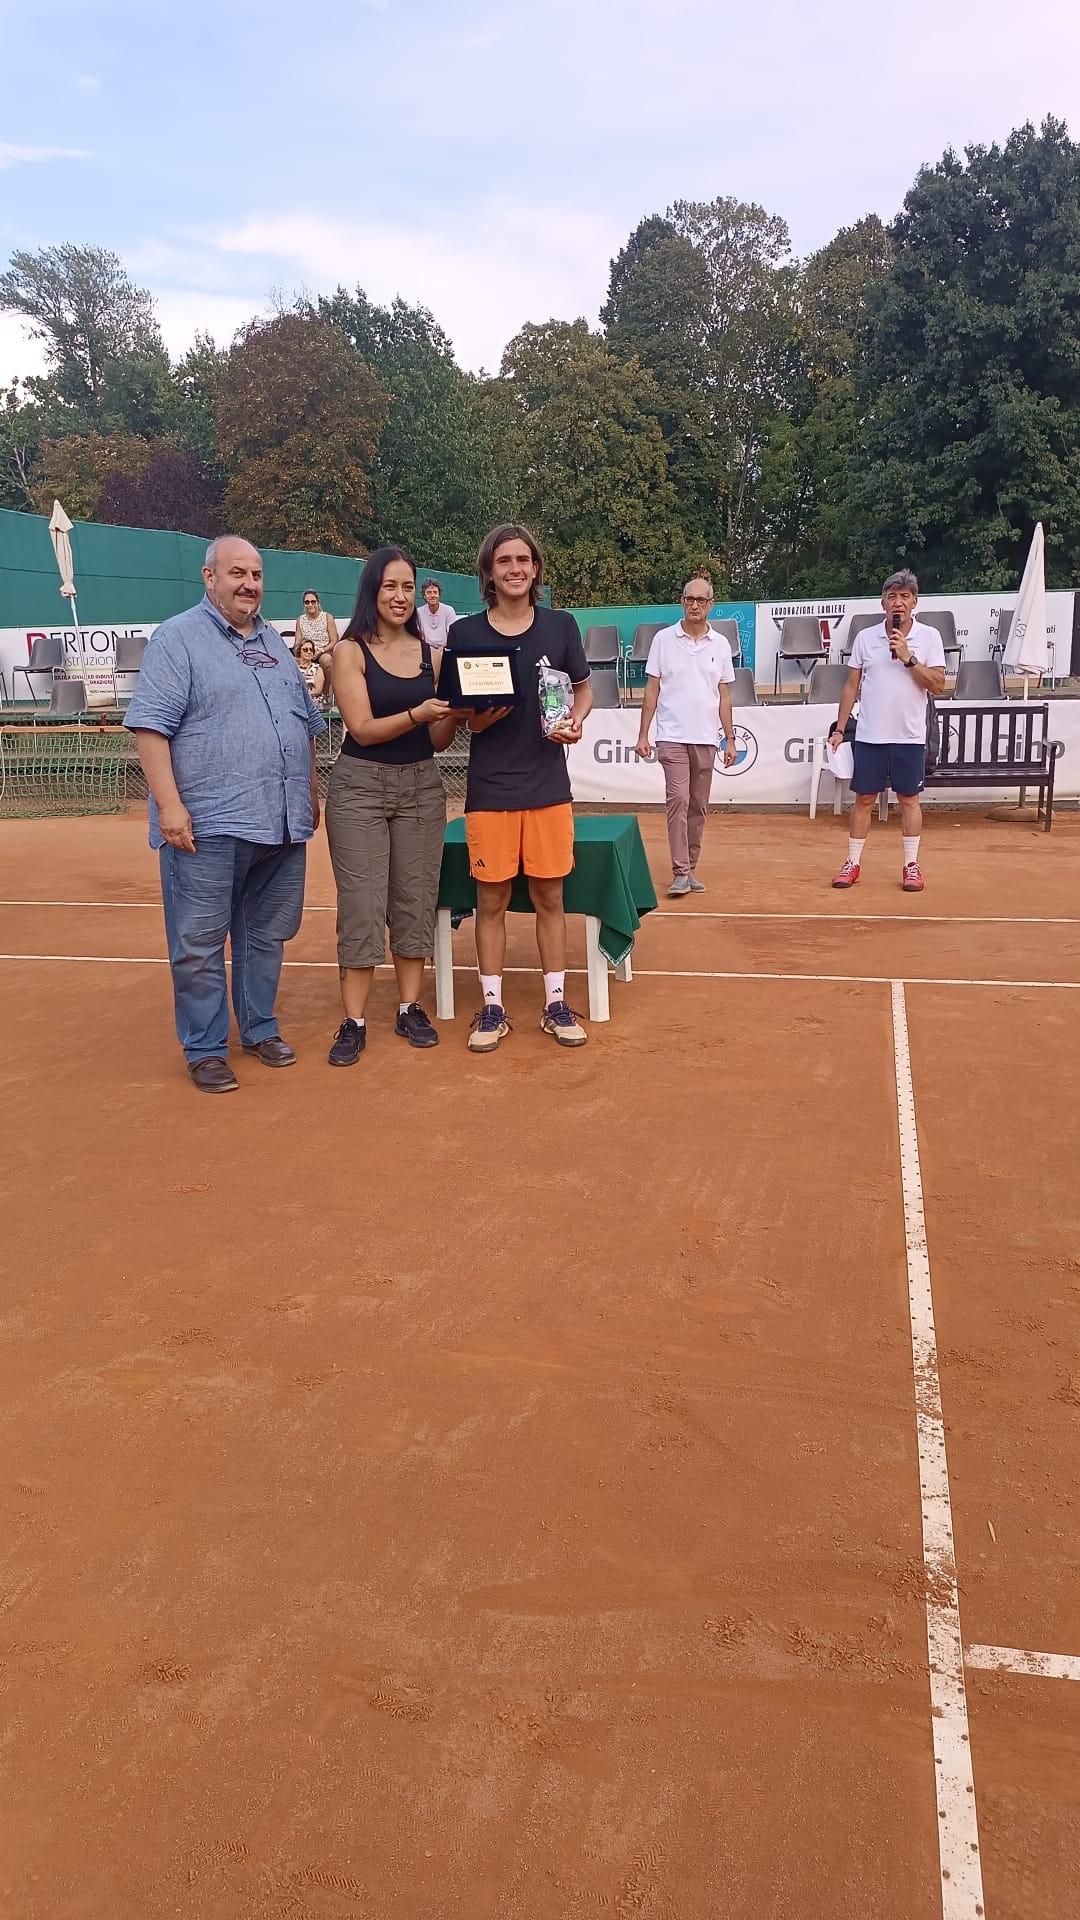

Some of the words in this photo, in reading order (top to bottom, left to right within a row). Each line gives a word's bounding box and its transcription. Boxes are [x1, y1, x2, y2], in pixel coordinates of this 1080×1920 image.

[771, 606, 814, 616] LAVORAZIONE
[818, 604, 846, 614] LAMIERE
[594, 739, 658, 764] Gino
